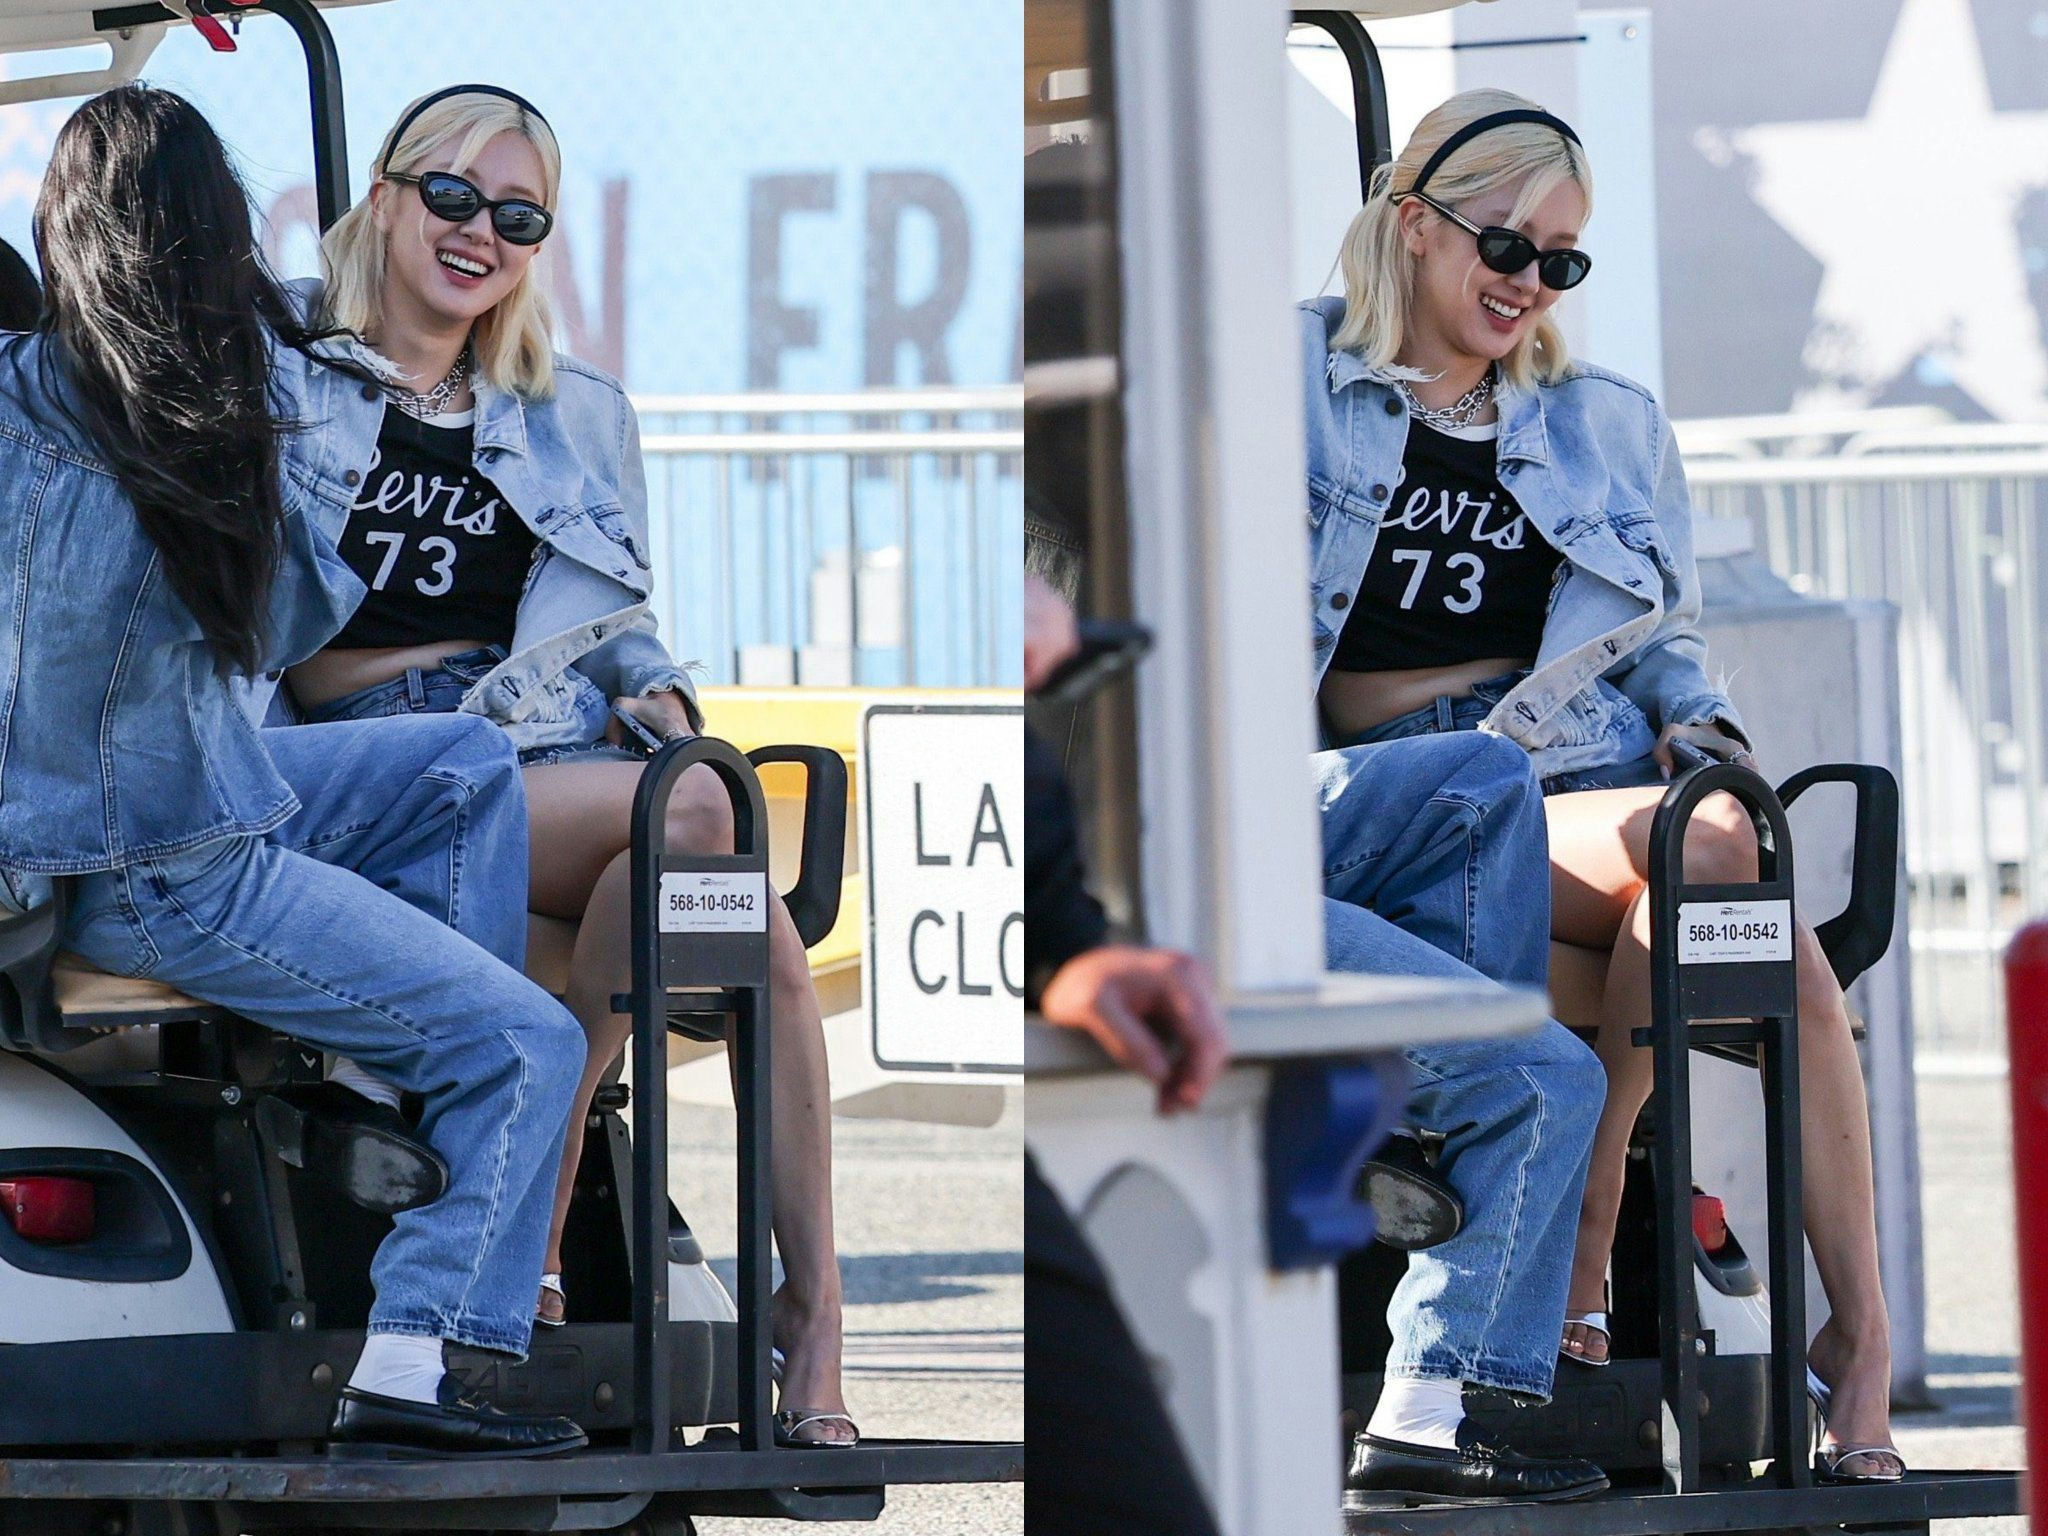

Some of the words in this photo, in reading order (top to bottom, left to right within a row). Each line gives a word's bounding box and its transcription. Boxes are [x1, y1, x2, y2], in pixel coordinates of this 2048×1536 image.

[747, 168, 1024, 474] FR
[1378, 464, 1527, 550] evi's
[365, 531, 457, 597] 73
[1392, 549, 1485, 614] 73
[914, 781, 1014, 867] LA
[670, 894, 754, 911] 568-10-0542
[1689, 922, 1779, 942] 568-10-0542
